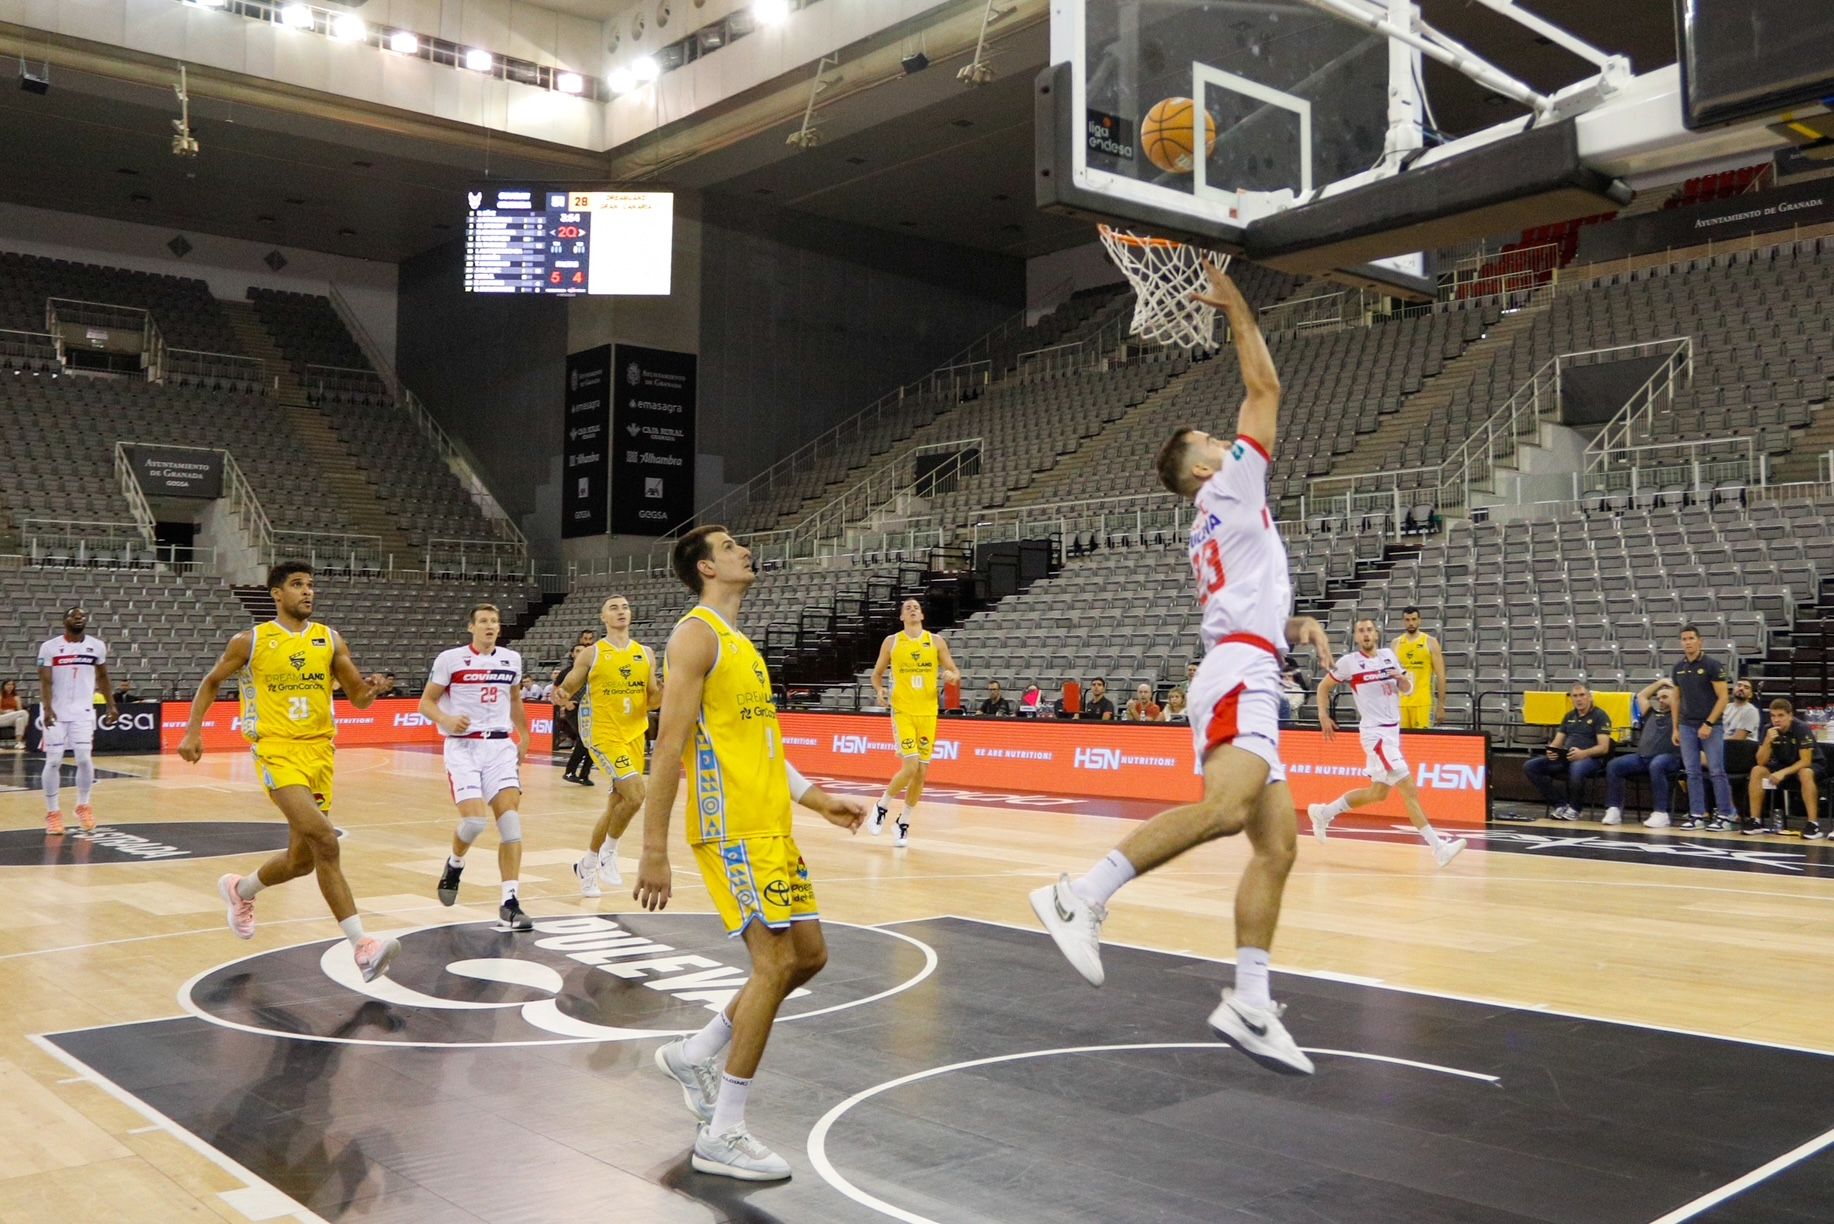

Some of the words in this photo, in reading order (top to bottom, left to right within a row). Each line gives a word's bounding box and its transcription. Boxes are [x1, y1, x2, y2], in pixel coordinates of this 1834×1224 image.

[1089, 120, 1109, 138] liga
[1089, 137, 1132, 158] endesa
[574, 196, 588, 207] 28
[1694, 208, 1761, 229] AYUNTAMIENTO
[1763, 206, 1777, 217] DE
[1778, 198, 1824, 214] GRANADA
[550, 271, 563, 284] 5
[571, 271, 584, 284] 4
[638, 401, 683, 414] emasagra
[144, 458, 210, 471] AYUNTAMIENTO
[163, 469, 204, 480] GRANADA
[72, 667, 79, 680] 7
[265, 673, 326, 683] DREAMLAND
[481, 687, 498, 703] 29
[288, 696, 311, 721] 21
[530, 719, 554, 734] HSN
[767, 727, 775, 761] 1
[832, 735, 868, 754] HSN
[932, 740, 961, 761] SN
[1074, 747, 1121, 770] HSN
[1120, 756, 1176, 767] NUTRITION!
[1290, 764, 1312, 774] ARE
[1416, 762, 1485, 791] HSN
